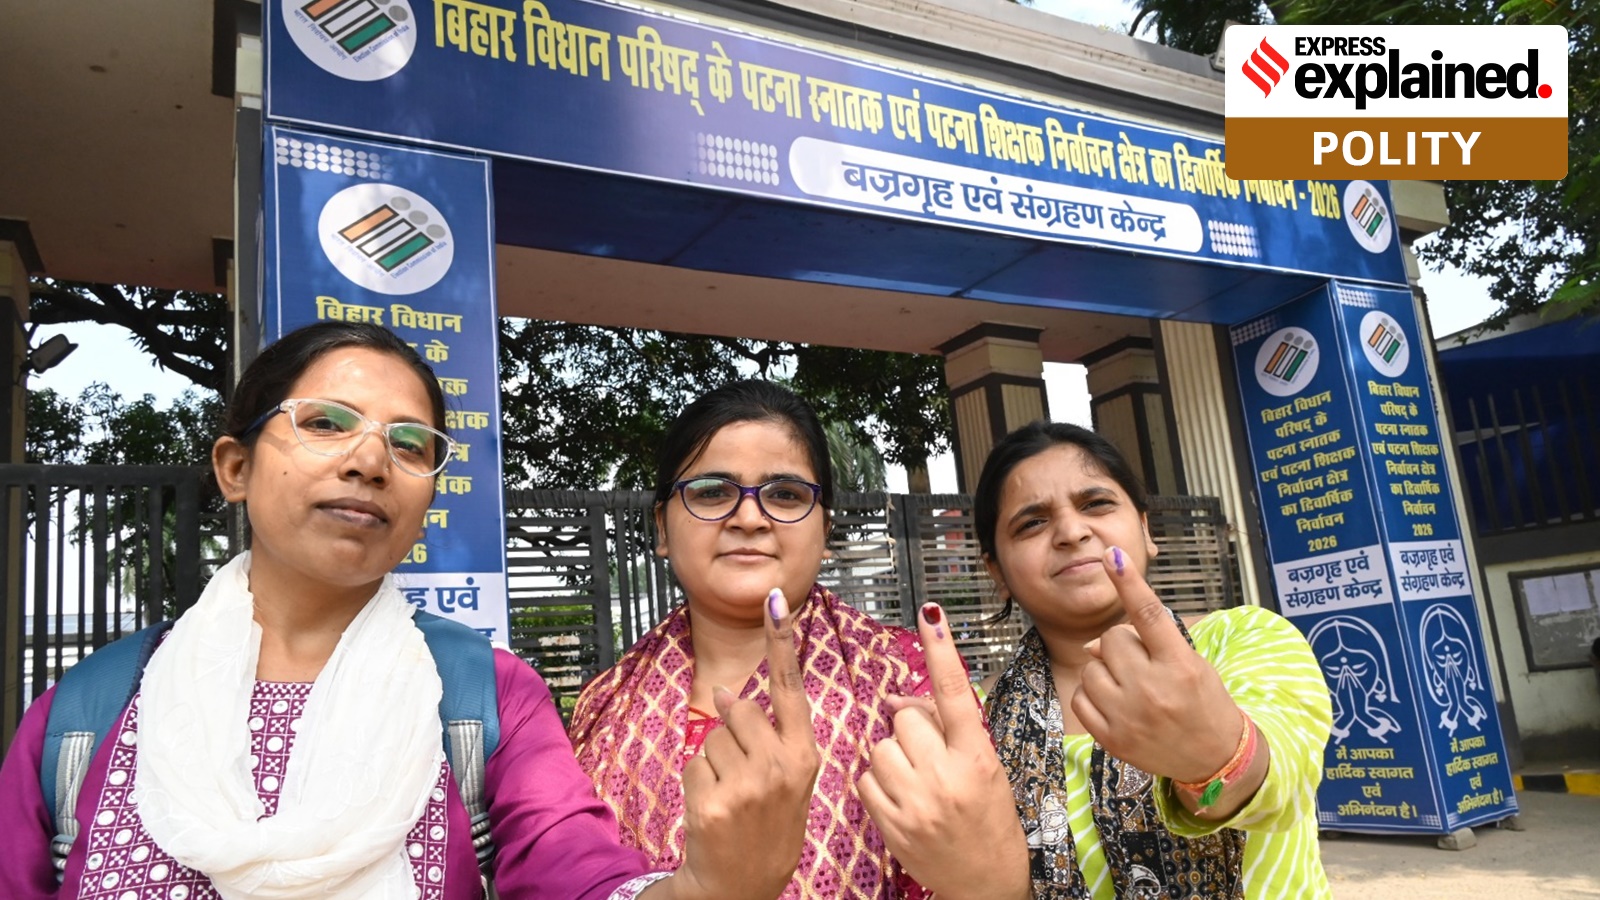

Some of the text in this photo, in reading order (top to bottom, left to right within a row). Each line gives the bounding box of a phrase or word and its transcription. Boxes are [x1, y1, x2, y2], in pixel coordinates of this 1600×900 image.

[523, 0, 611, 81] विधान
[617, 25, 705, 116] परिषद्
[706, 41, 733, 103] के
[739, 61, 802, 119] पटना
[806, 76, 884, 134] स्नातक
[887, 88, 922, 143] एवं
[924, 103, 979, 155] पटना
[979, 103, 1045, 166] शिक्षक
[1045, 117, 1116, 180] निर्वाचन
[1117, 131, 1149, 185] क्षेत्र
[1148, 149, 1175, 190] का
[1307, 180, 1341, 220] 2026
[960, 176, 1003, 214] एवं
[1008, 184, 1104, 229] संग्रहण
[1108, 200, 1166, 242] केन्द्र
[316, 296, 463, 332] बिहार विधान
[424, 339, 449, 363] के
[1367, 380, 1420, 398] बिहार विधान
[1261, 390, 1331, 424] बिहार विधान
[1408, 401, 1419, 417] के
[1275, 411, 1328, 438] परिषद् के
[1374, 423, 1398, 435] पटना
[1266, 429, 1341, 460] पटना स्नातक
[1371, 440, 1386, 455] एवं
[1387, 443, 1410, 455] पटना
[1261, 446, 1356, 482] एवं पटना शिक्षक
[1385, 460, 1420, 475] निर्वाचन
[1277, 469, 1349, 498] निर्वाचन क्षेत्र
[1389, 483, 1403, 495] का
[1280, 503, 1298, 516] का
[1402, 499, 1437, 516] निर्वाचन
[1296, 512, 1344, 534] निर्वाचन
[1412, 523, 1434, 536] 2026
[1307, 535, 1338, 552] 2026
[1438, 542, 1455, 564] एवं
[1344, 550, 1370, 574] एवं
[1400, 567, 1465, 593] संग्रहण केन्द्र
[435, 576, 480, 614] एवं
[1284, 577, 1383, 608] संग्रहण केन्द्र
[1459, 735, 1486, 752] आपका
[1350, 748, 1395, 760] आपका
[1324, 763, 1414, 780] हार्दिक स्वागत
[1444, 755, 1472, 777] हार्दिक
[1361, 782, 1382, 798] एवं
[1469, 771, 1482, 790] एवं
[1337, 800, 1398, 817] अभिनंदन
